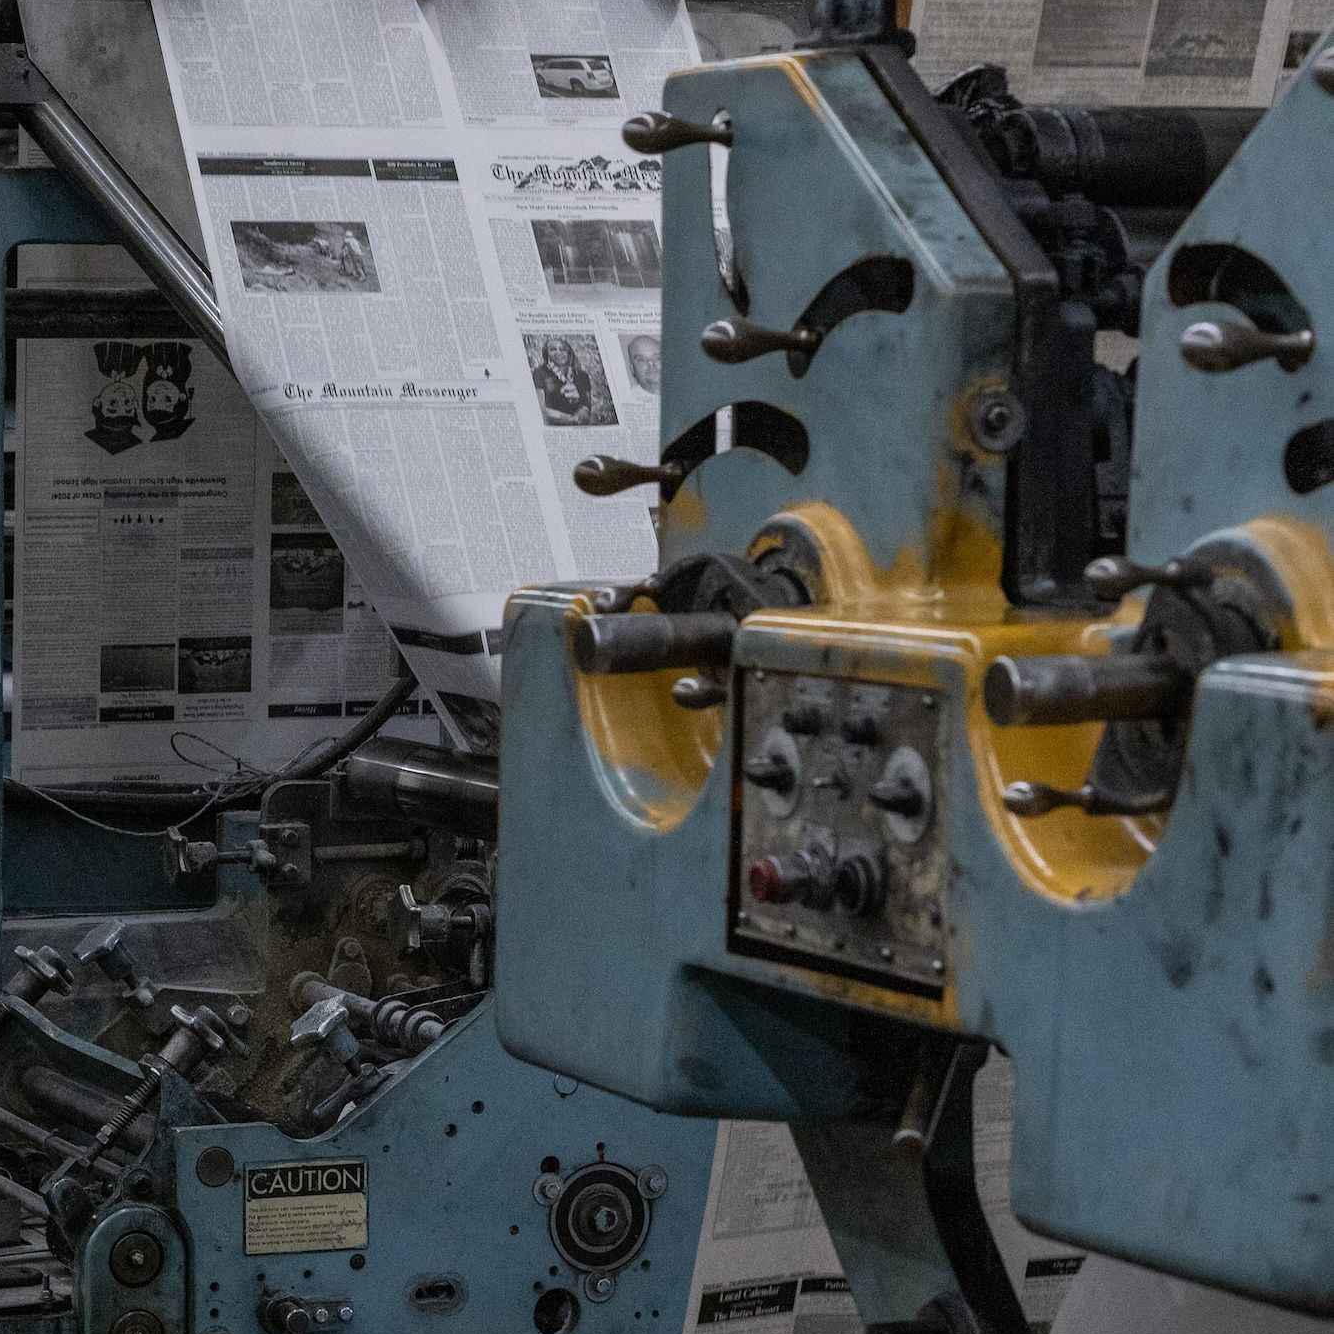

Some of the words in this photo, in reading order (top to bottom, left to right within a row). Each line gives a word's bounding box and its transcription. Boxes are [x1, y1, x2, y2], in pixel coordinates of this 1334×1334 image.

[491, 163, 524, 184] The
[530, 163, 614, 182] Mountain
[283, 383, 313, 402] The
[320, 382, 393, 401] Mountain
[400, 382, 477, 402] Messenger
[251, 1167, 361, 1195] CAUTION
